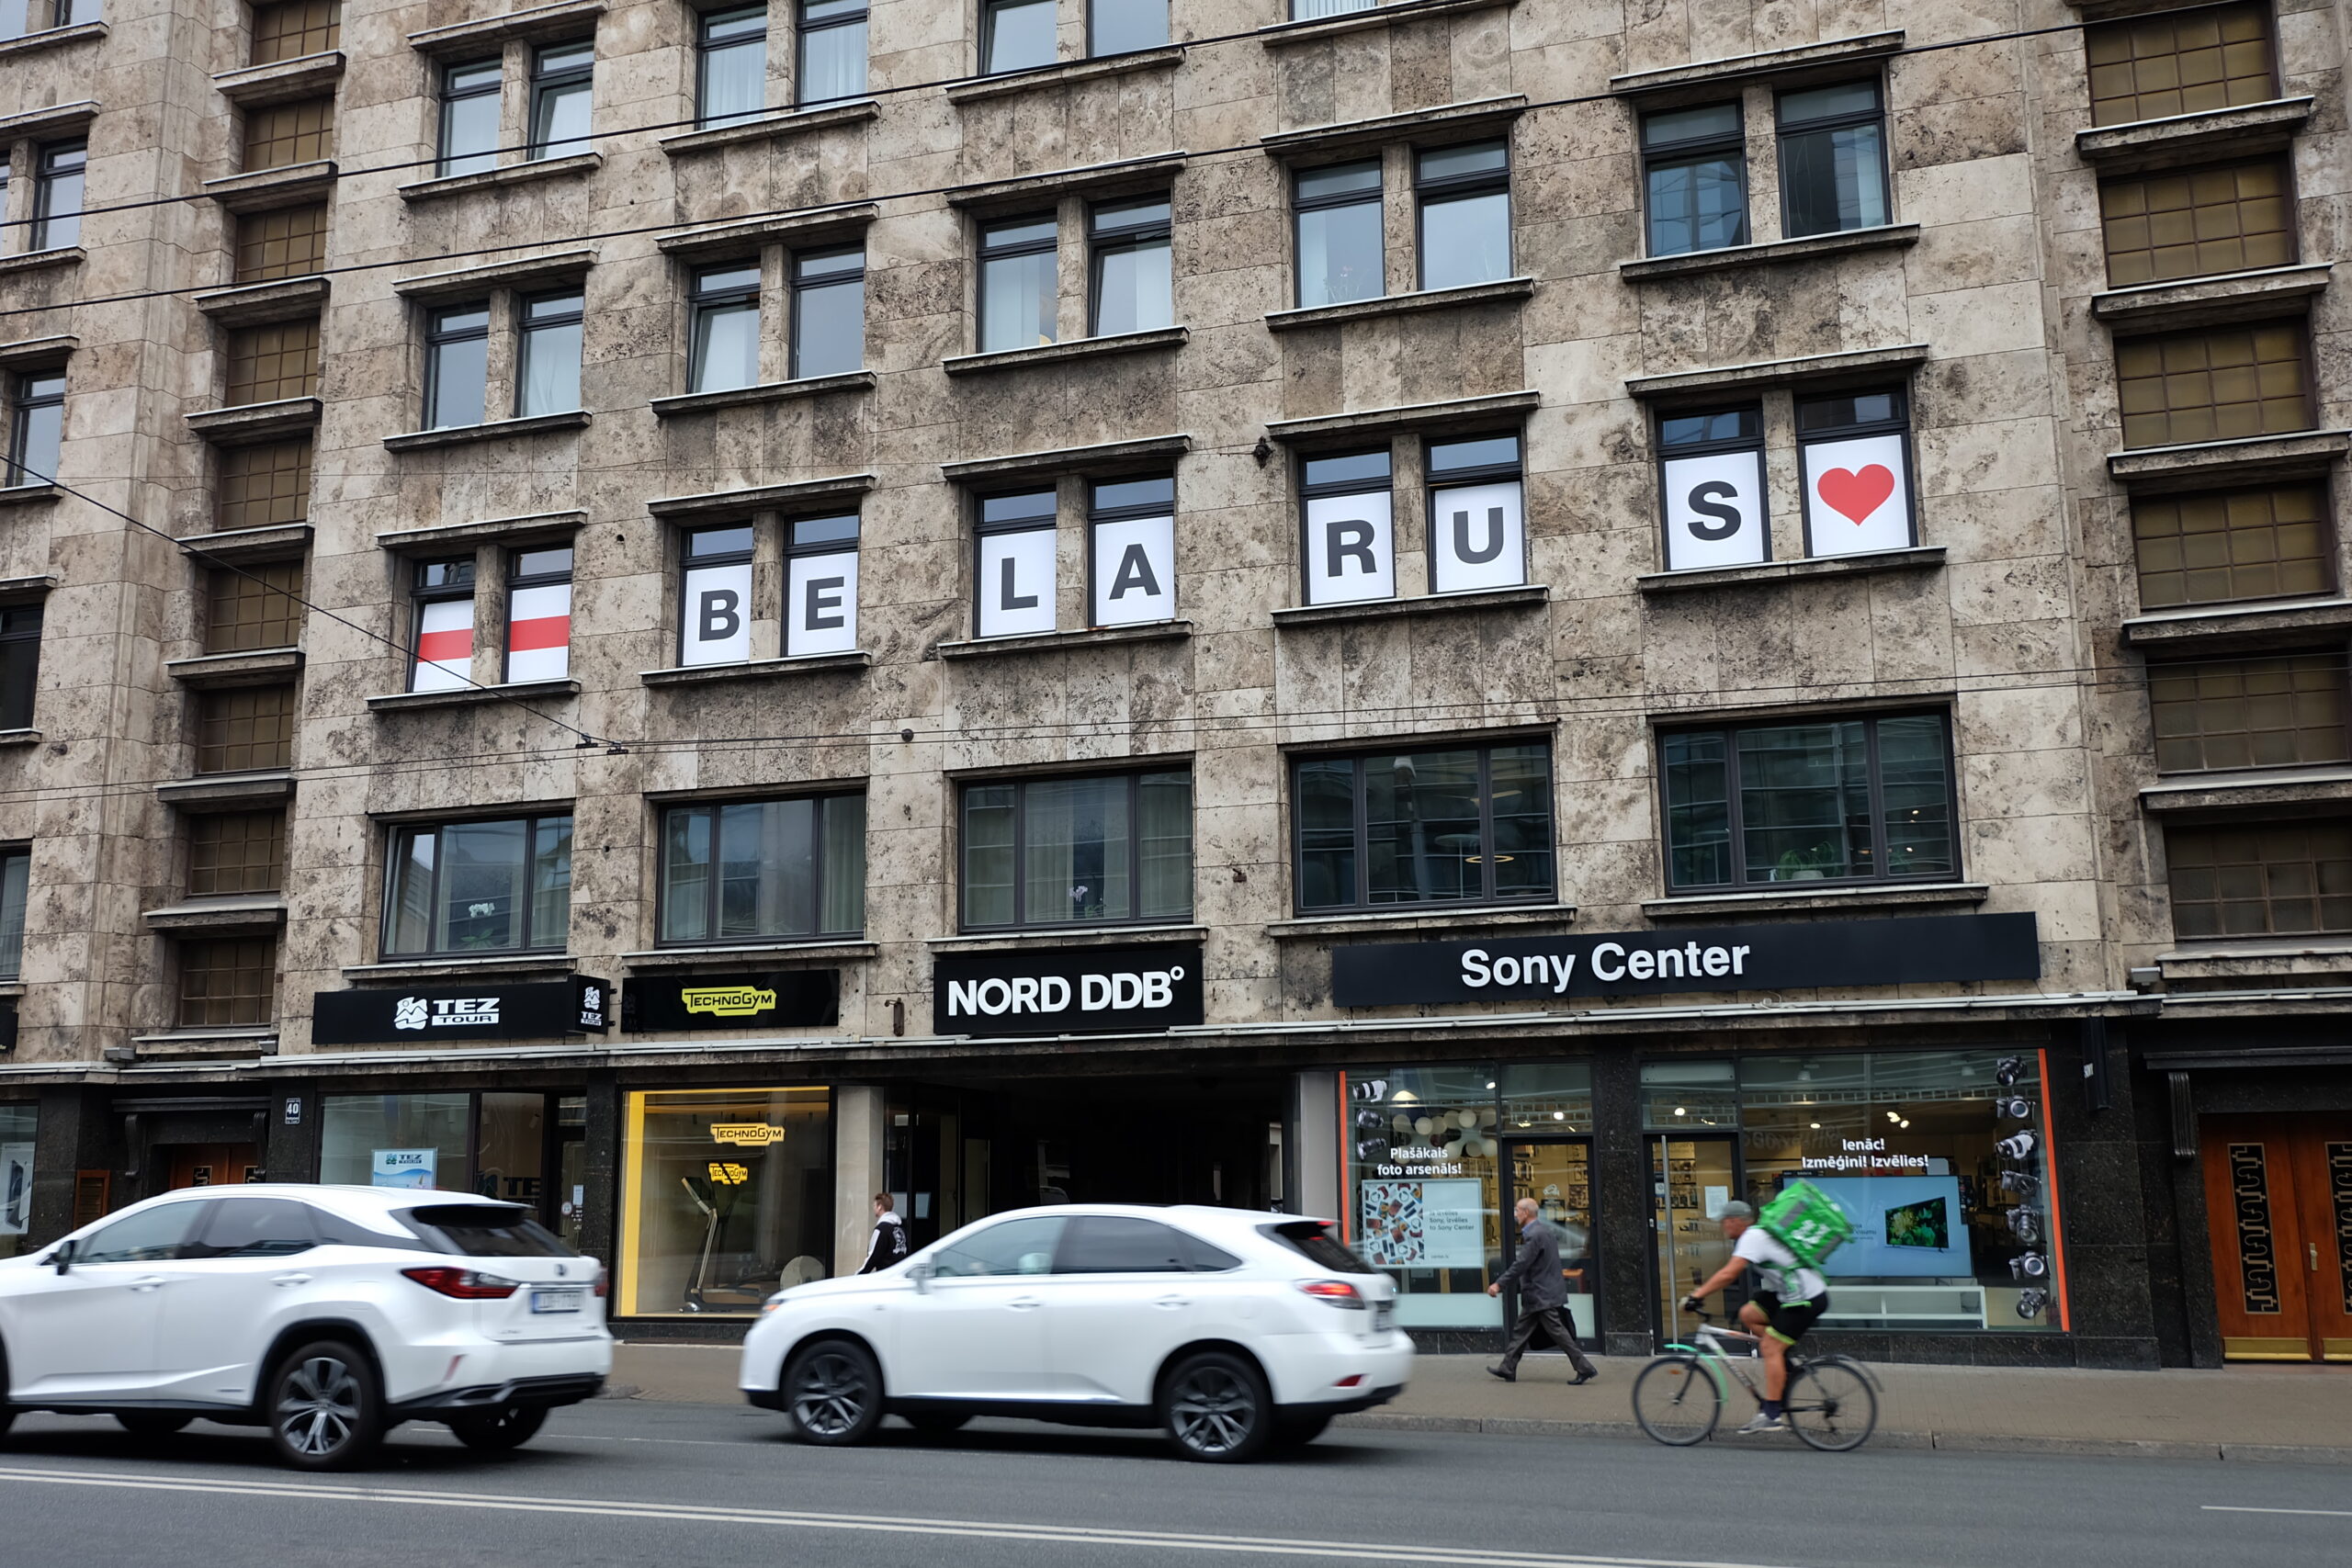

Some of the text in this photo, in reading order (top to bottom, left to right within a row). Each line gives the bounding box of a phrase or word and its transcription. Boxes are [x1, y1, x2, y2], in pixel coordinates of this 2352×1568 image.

[1461, 941, 1750, 994] Sony Center
[947, 976, 1071, 1016] NORD
[432, 998, 501, 1015] TEZ
[437, 1015, 493, 1023] TOUR
[581, 1011, 603, 1021] TEZ
[287, 1102, 299, 1114] 40
[1842, 1138, 1885, 1151] Ienāc!
[1390, 1146, 1449, 1159] Plašākais
[1871, 1155, 1929, 1168] Izvēlies!
[1377, 1162, 1462, 1176] foto arsenāls!
[503, 1177, 541, 1196] TE
